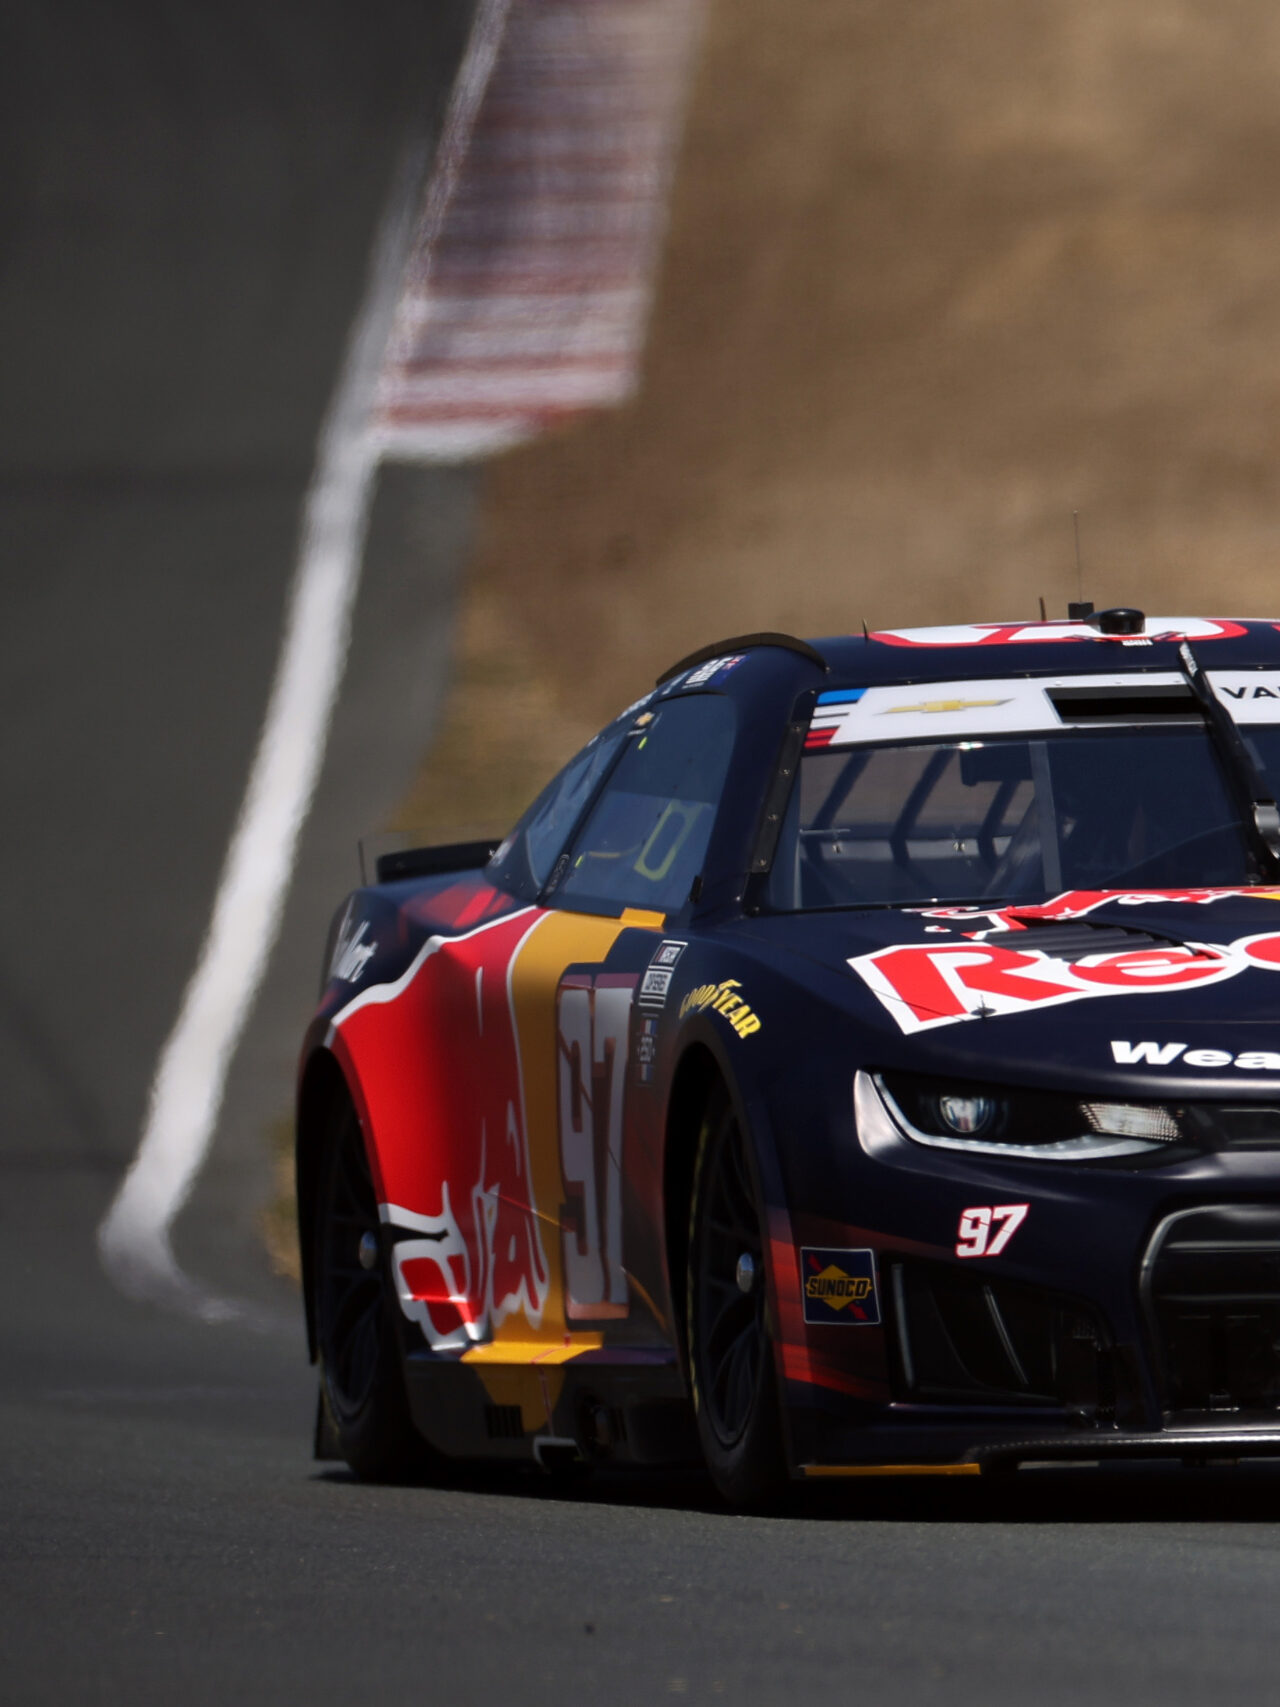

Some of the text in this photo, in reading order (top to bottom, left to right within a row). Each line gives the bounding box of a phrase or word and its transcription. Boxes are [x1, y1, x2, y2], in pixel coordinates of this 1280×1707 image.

[556, 976, 641, 1318] 97
[956, 1203, 1030, 1258] 97
[808, 1278, 869, 1297] SUNOCO
